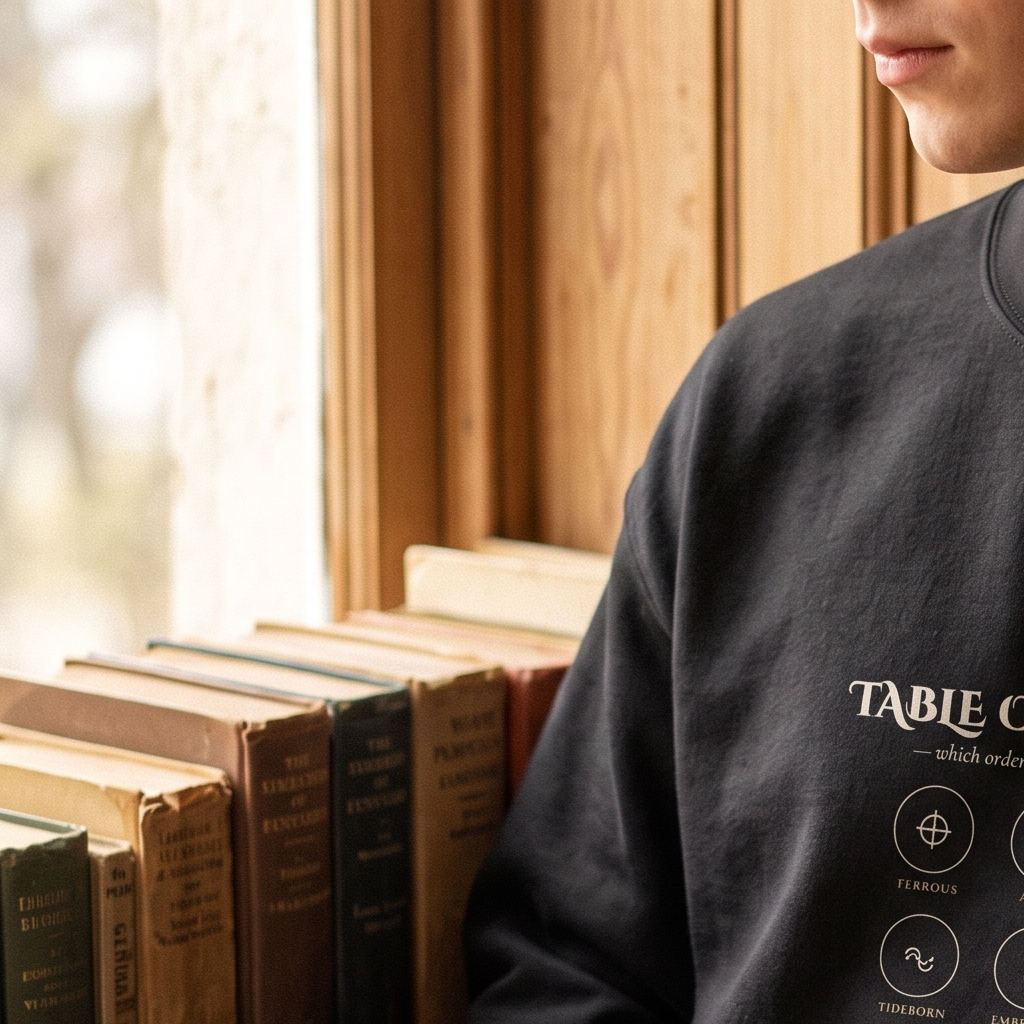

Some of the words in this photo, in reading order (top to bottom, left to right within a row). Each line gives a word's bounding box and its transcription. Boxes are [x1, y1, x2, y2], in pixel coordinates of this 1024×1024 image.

[849, 680, 987, 738] TABLE
[936, 744, 979, 763] which
[898, 879, 957, 894] FERROUS
[879, 1002, 945, 1018] TIDEBORN
